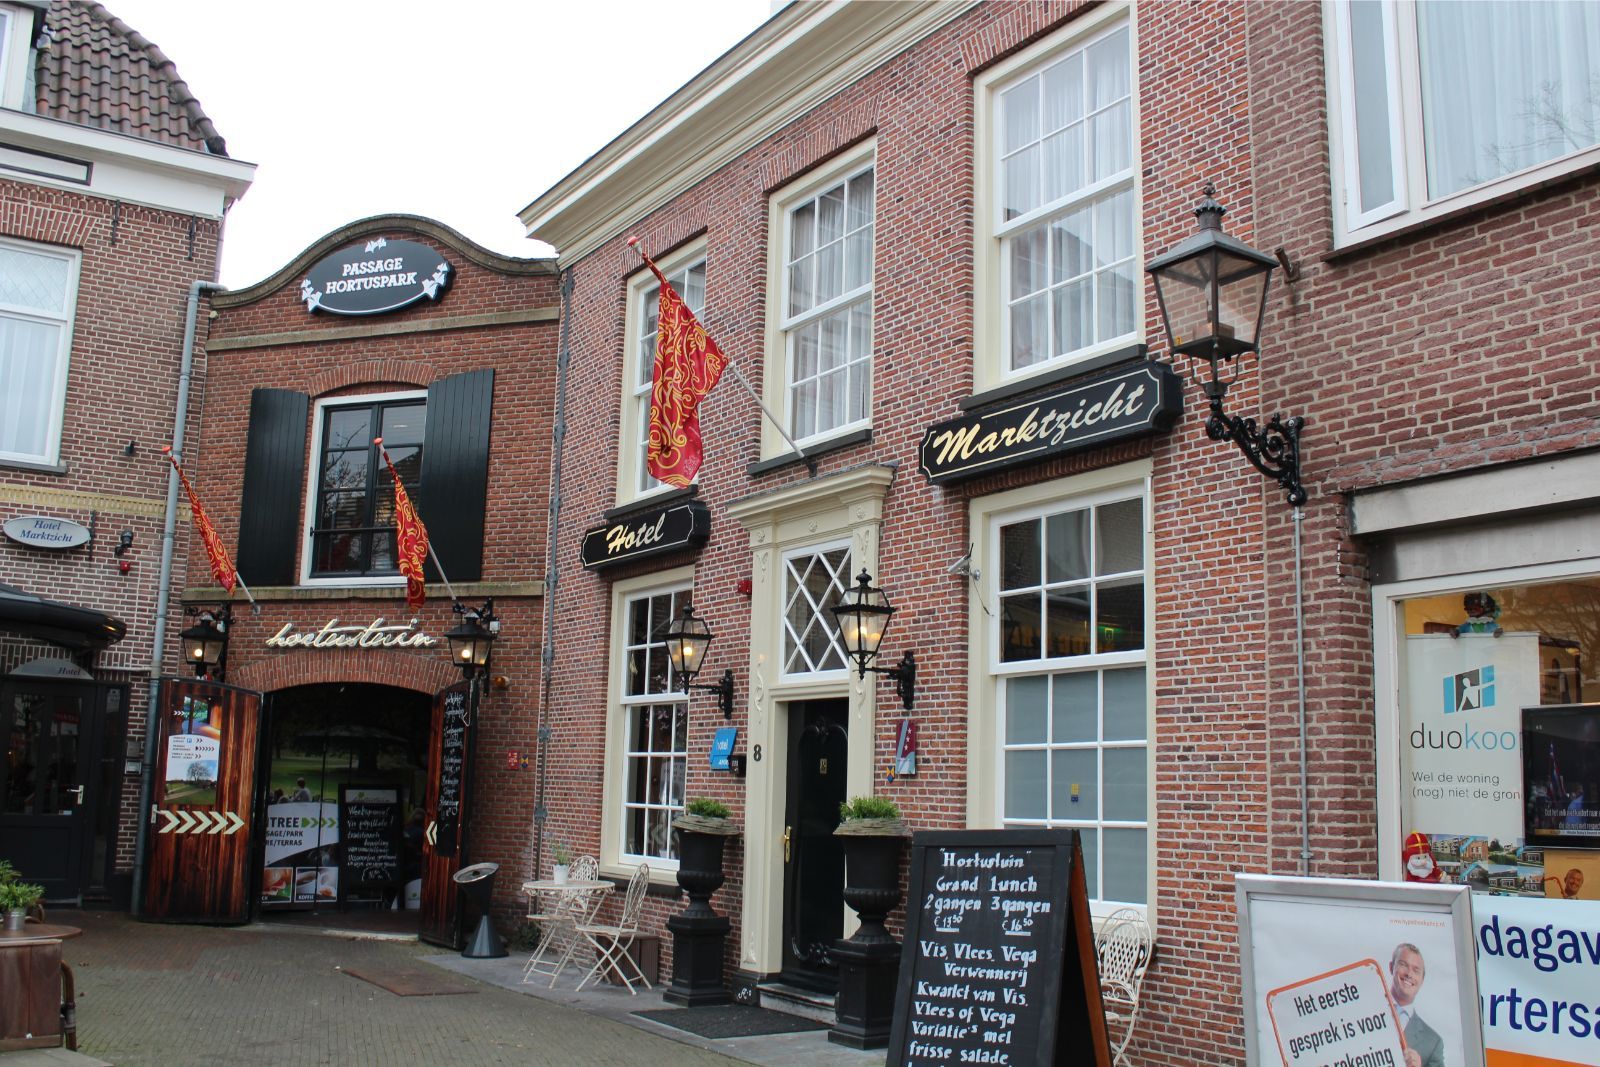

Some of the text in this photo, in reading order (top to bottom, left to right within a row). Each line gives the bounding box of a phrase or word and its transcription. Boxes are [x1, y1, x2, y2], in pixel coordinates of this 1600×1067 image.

[342, 257, 403, 277] PASSAGE
[325, 272, 418, 295] HORTUSPARK
[932, 382, 1145, 466] Marktzicht
[20, 529, 72, 542] Marktzicht
[34, 520, 61, 530] Hotel
[605, 512, 666, 555] Hotel
[1410, 723, 1522, 758] duokoo
[753, 743, 763, 762] 8
[1412, 771, 1500, 786] Wel de woning
[1412, 786, 1444, 799] (nog)
[1448, 787, 1469, 798] niet
[1473, 788, 1489, 799] de
[936, 876, 979, 892] Grand
[1001, 946, 1037, 968] Vega
[944, 962, 1028, 987] Verwennerij
[973, 990, 996, 1003] van
[1294, 982, 1360, 1017] Het eerste
[914, 1001, 1016, 1029] Vlees of Vega
[1481, 988, 1600, 1042] rters
[1289, 1012, 1387, 1059] gesprek is voor
[909, 1041, 953, 1058] frisse
